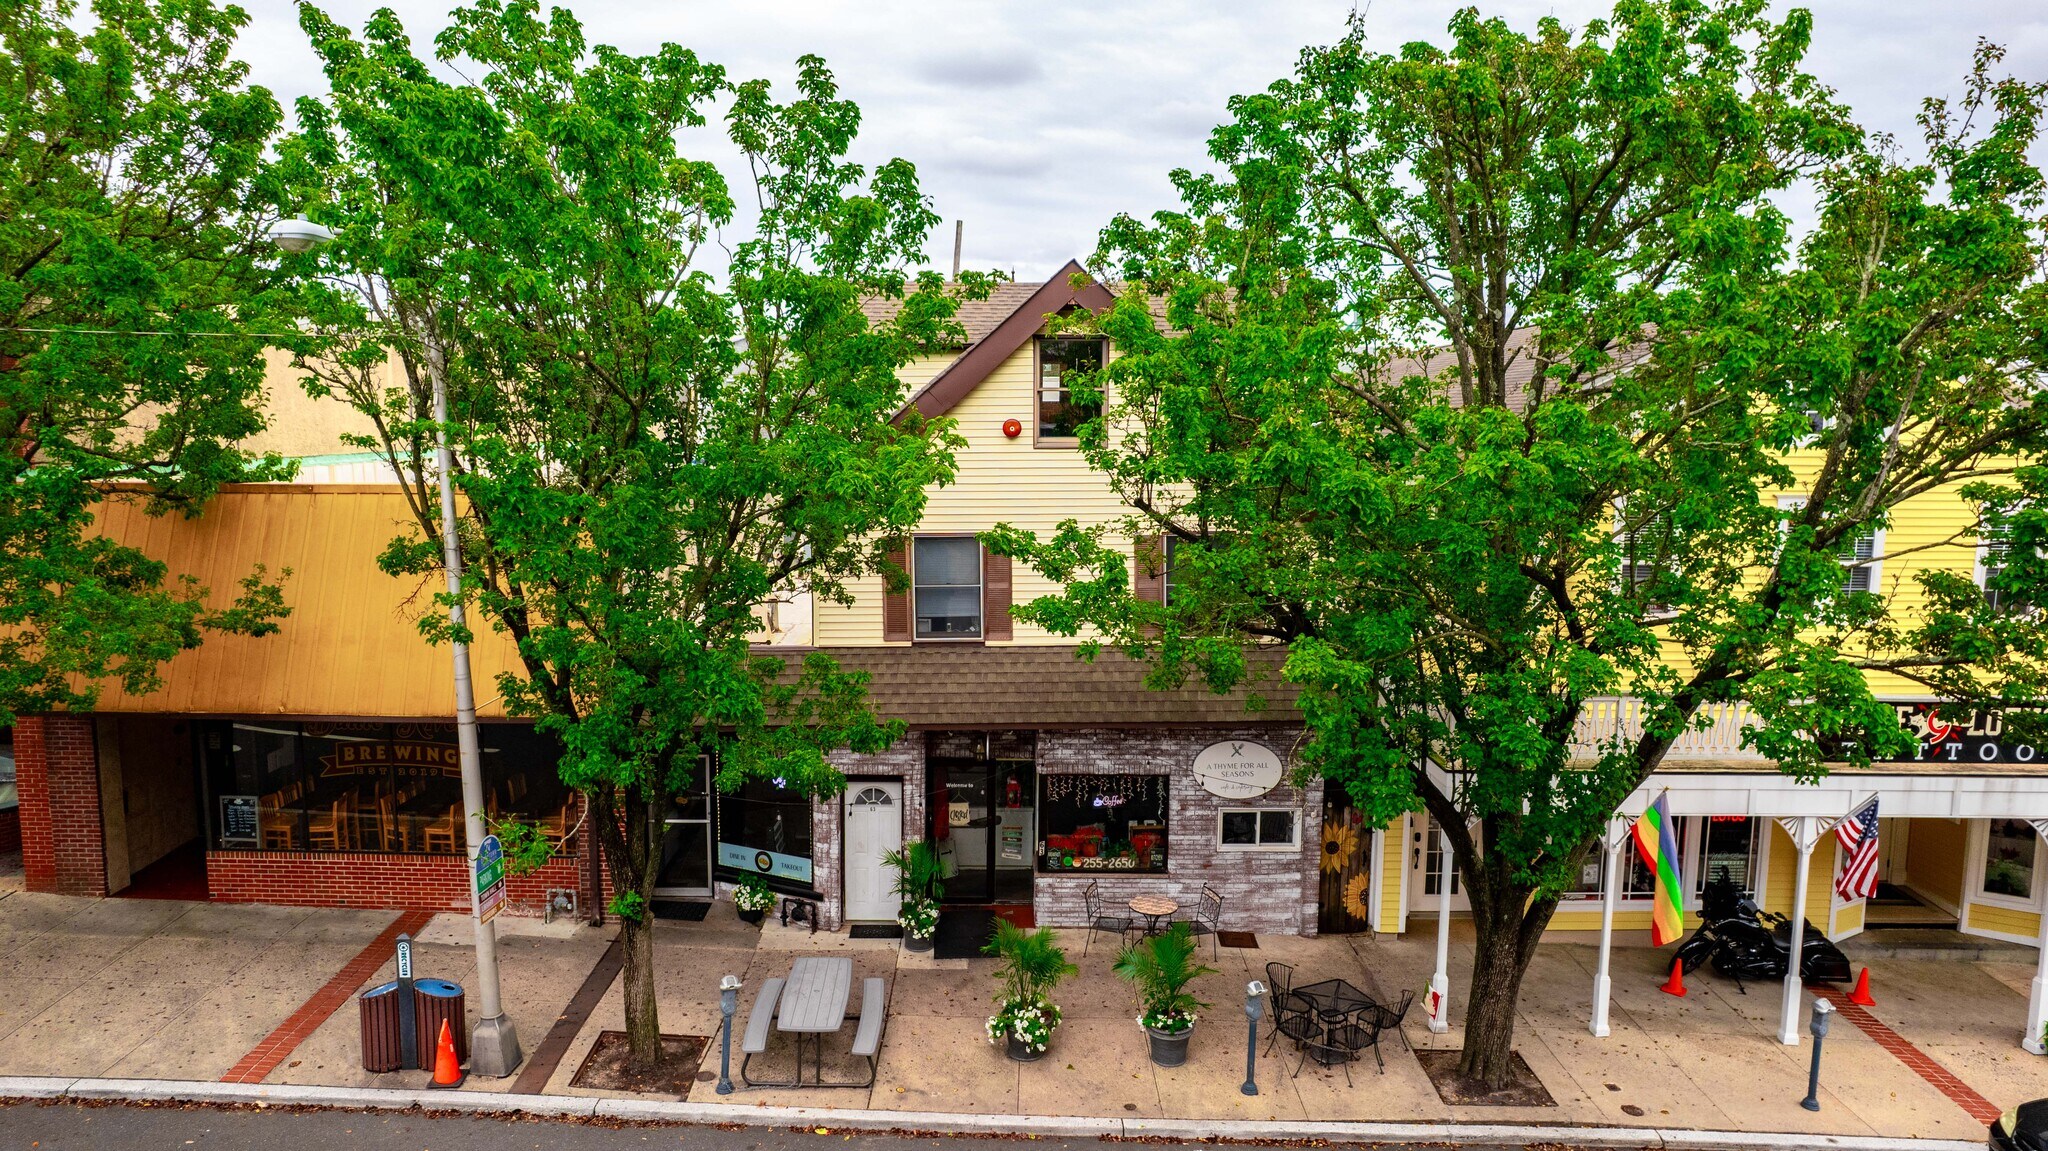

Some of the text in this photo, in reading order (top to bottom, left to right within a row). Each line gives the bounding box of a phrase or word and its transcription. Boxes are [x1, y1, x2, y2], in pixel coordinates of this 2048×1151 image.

[343, 745, 457, 765] BREWING
[356, 766, 388, 775] EST
[729, 852, 740, 860] DINE
[781, 862, 803, 872] TAKEOUT
[1083, 858, 1135, 869] 255-2650
